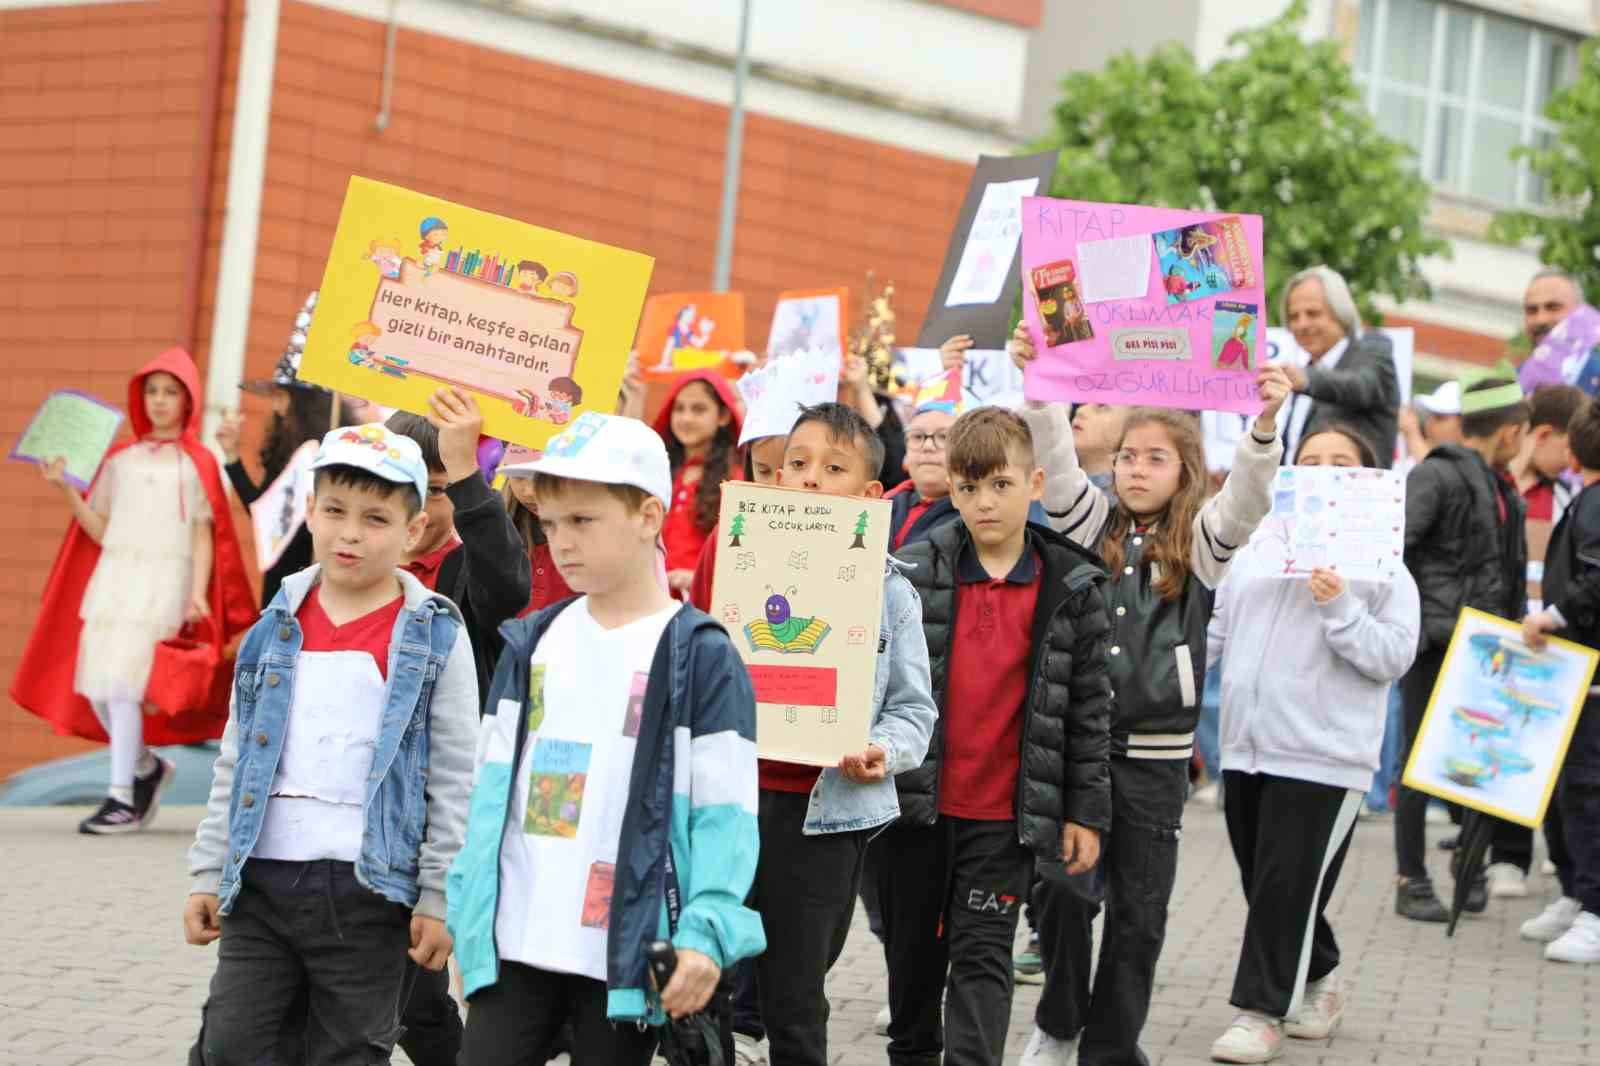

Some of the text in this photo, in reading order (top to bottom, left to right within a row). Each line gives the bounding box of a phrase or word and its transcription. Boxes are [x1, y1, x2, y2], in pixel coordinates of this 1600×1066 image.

[381, 288, 571, 354] Her kitap, keşfe açılan
[387, 319, 550, 373] gizli bir anahtardır.
